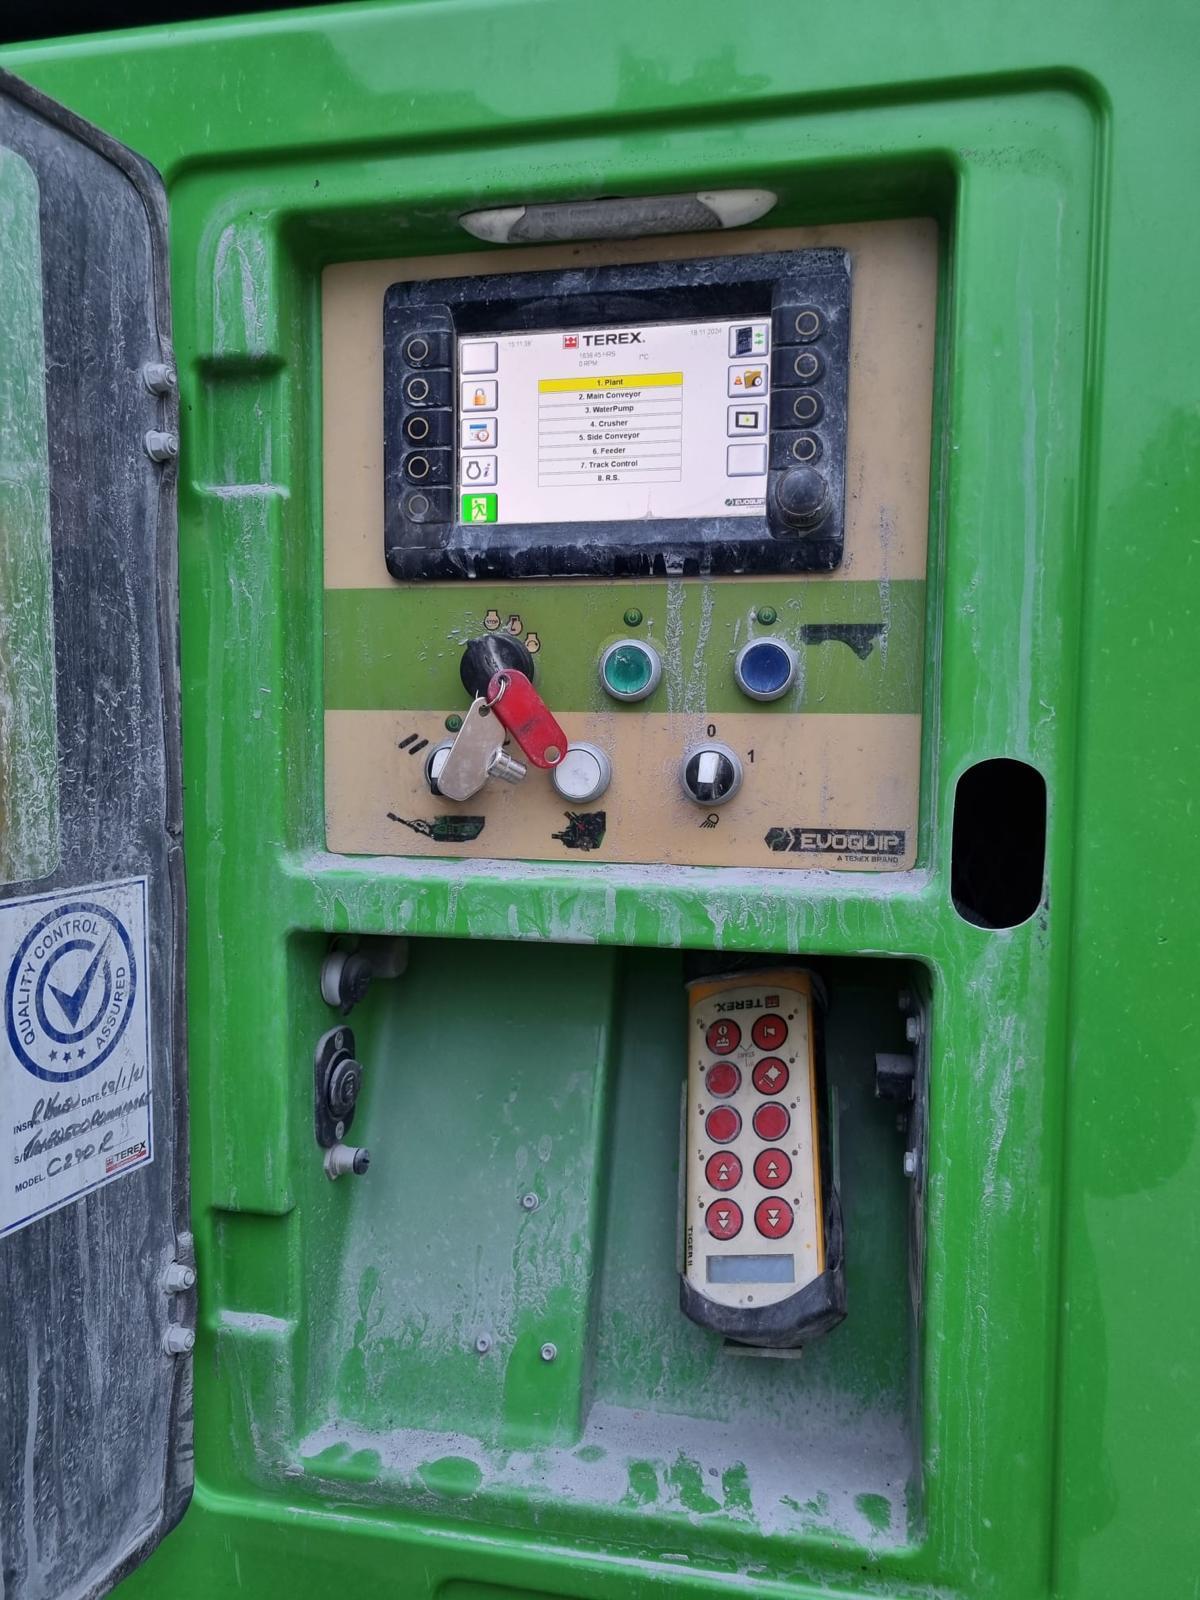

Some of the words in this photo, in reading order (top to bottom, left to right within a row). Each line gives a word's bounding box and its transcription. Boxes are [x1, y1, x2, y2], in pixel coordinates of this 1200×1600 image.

[605, 391, 641, 400] Conveyor
[592, 405, 634, 413] WaterPump
[586, 433, 603, 441] Side
[604, 432, 641, 440] Conveyor
[610, 460, 638, 468] Control
[597, 474, 604, 482] 8.
[706, 723, 717, 738] 0
[747, 749, 754, 763] 1
[800, 832, 900, 851] EVOQUIP
[844, 855, 869, 863] TEREX
[871, 856, 899, 864] BRAND
[18, 962, 36, 1046] QUALITY
[34, 919, 100, 960] CONTROL
[95, 966, 126, 1050] ASSURED
[114, 1140, 146, 1161] TEREX
